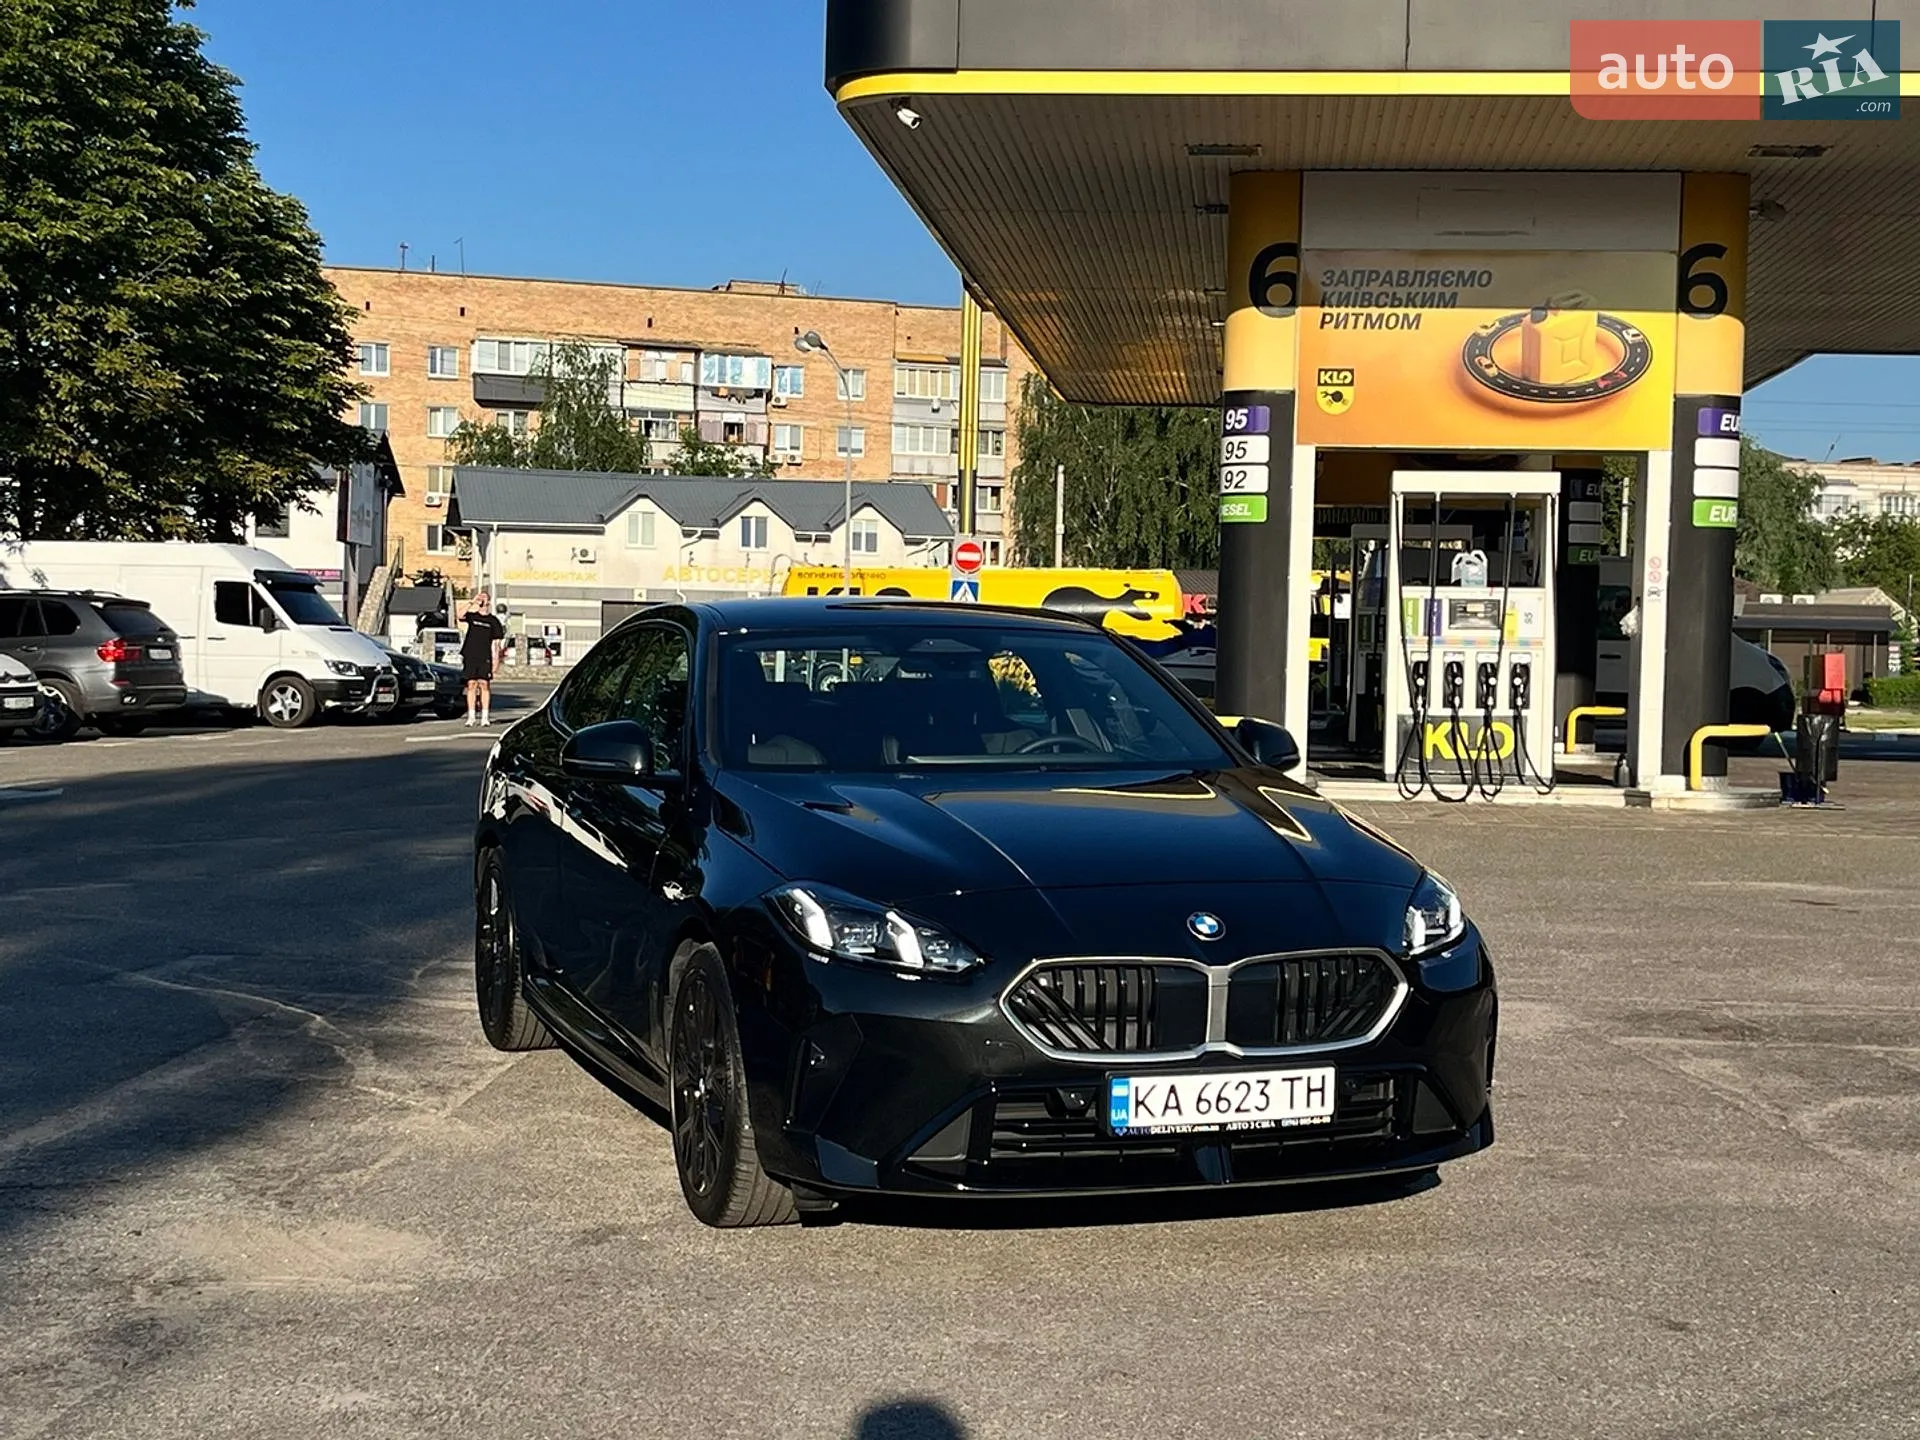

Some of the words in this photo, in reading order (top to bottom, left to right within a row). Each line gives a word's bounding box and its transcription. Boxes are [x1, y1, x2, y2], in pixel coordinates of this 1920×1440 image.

[1249, 242, 1298, 318] 6
[1319, 269, 1493, 288] ЗАПРАВЛЯЄМО
[1678, 242, 1729, 320] 6
[1319, 288, 1459, 309] КИЇВСЬКИМ
[1319, 312, 1422, 330] РИТМОМ
[1319, 370, 1353, 385] KLO
[1225, 408, 1249, 431] 95
[1225, 441, 1249, 461] 95
[1223, 470, 1248, 489] 92
[662, 565, 786, 584] АВТОСЕРВ
[1134, 1084, 1183, 1119] KA
[1196, 1079, 1271, 1115] 6623
[1281, 1075, 1326, 1110] TH
[1111, 1109, 1128, 1121] UA
